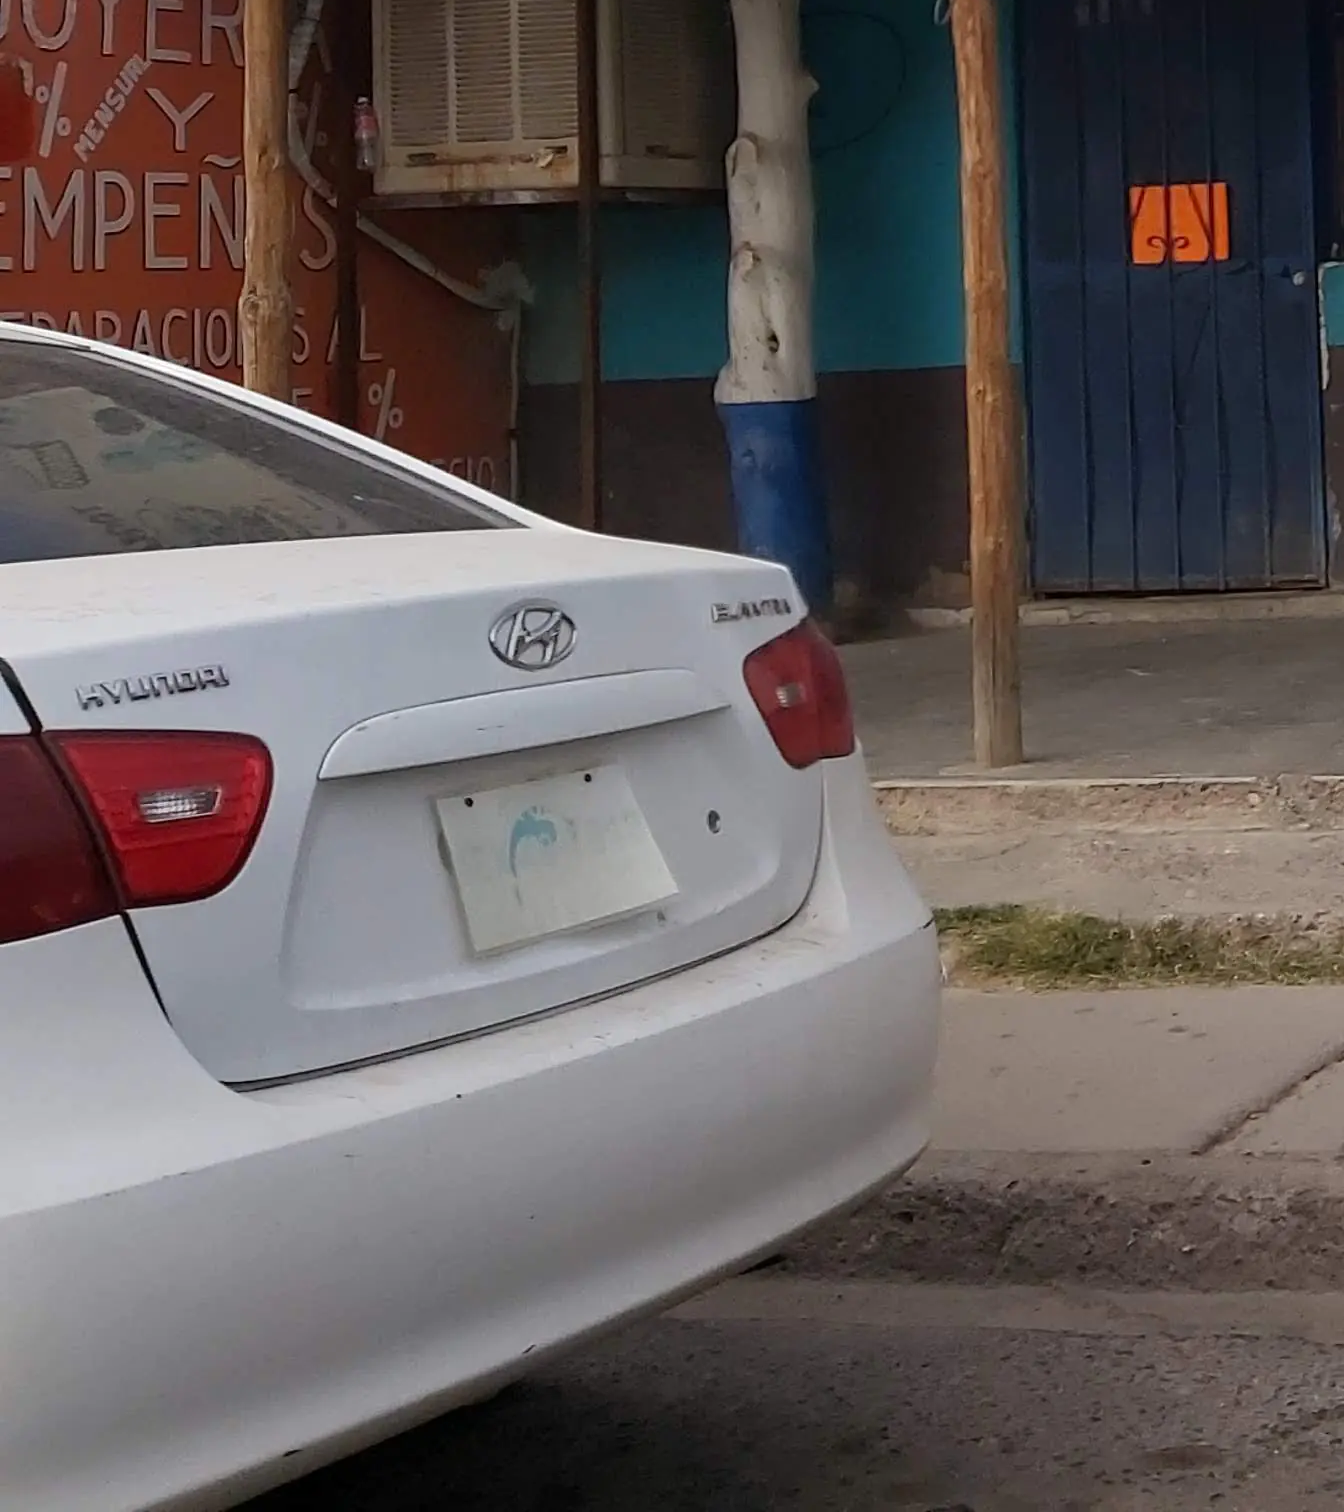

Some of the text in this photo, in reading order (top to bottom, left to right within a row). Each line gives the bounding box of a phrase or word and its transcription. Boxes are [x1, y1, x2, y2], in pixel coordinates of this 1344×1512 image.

[146, 87, 216, 152] Y
[0, 154, 338, 273] MPEÑS
[75, 663, 231, 711] HYUNDAI
